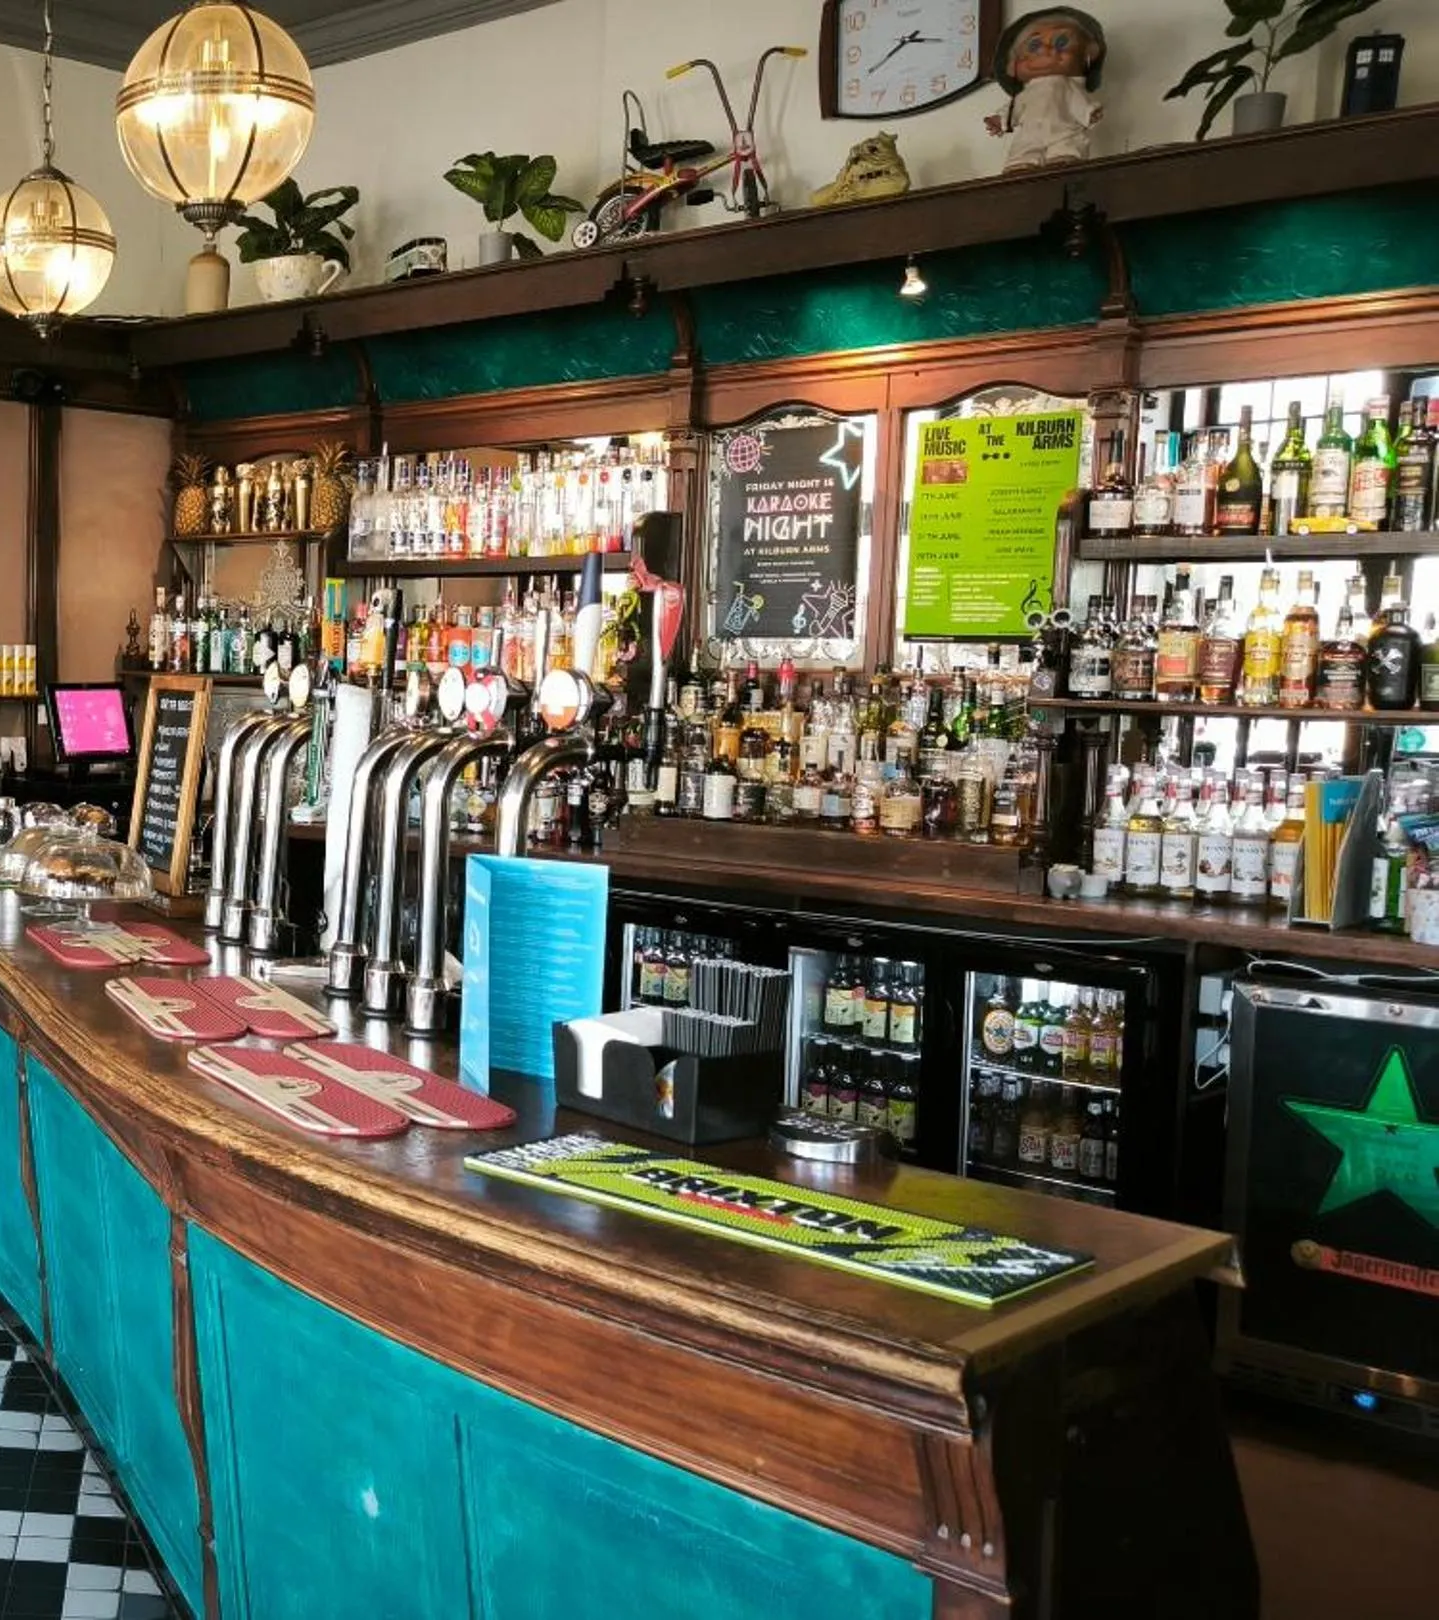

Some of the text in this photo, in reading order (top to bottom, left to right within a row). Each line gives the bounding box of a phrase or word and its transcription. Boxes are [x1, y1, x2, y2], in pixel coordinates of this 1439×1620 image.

[925, 427, 952, 442] LIVE
[978, 424, 992, 435] AT
[1016, 418, 1076, 436] KILBURN
[924, 440, 966, 456] MUSIC
[986, 435, 1005, 447] THE
[1032, 434, 1074, 451] ARMS
[745, 478, 835, 492] FRIDAY NIGHT IS
[747, 493, 832, 513] KARAOKE
[744, 514, 833, 542] NIGHT
[744, 544, 830, 556] AT KILBURN ARMS
[624, 1166, 905, 1240] BRIXTON
